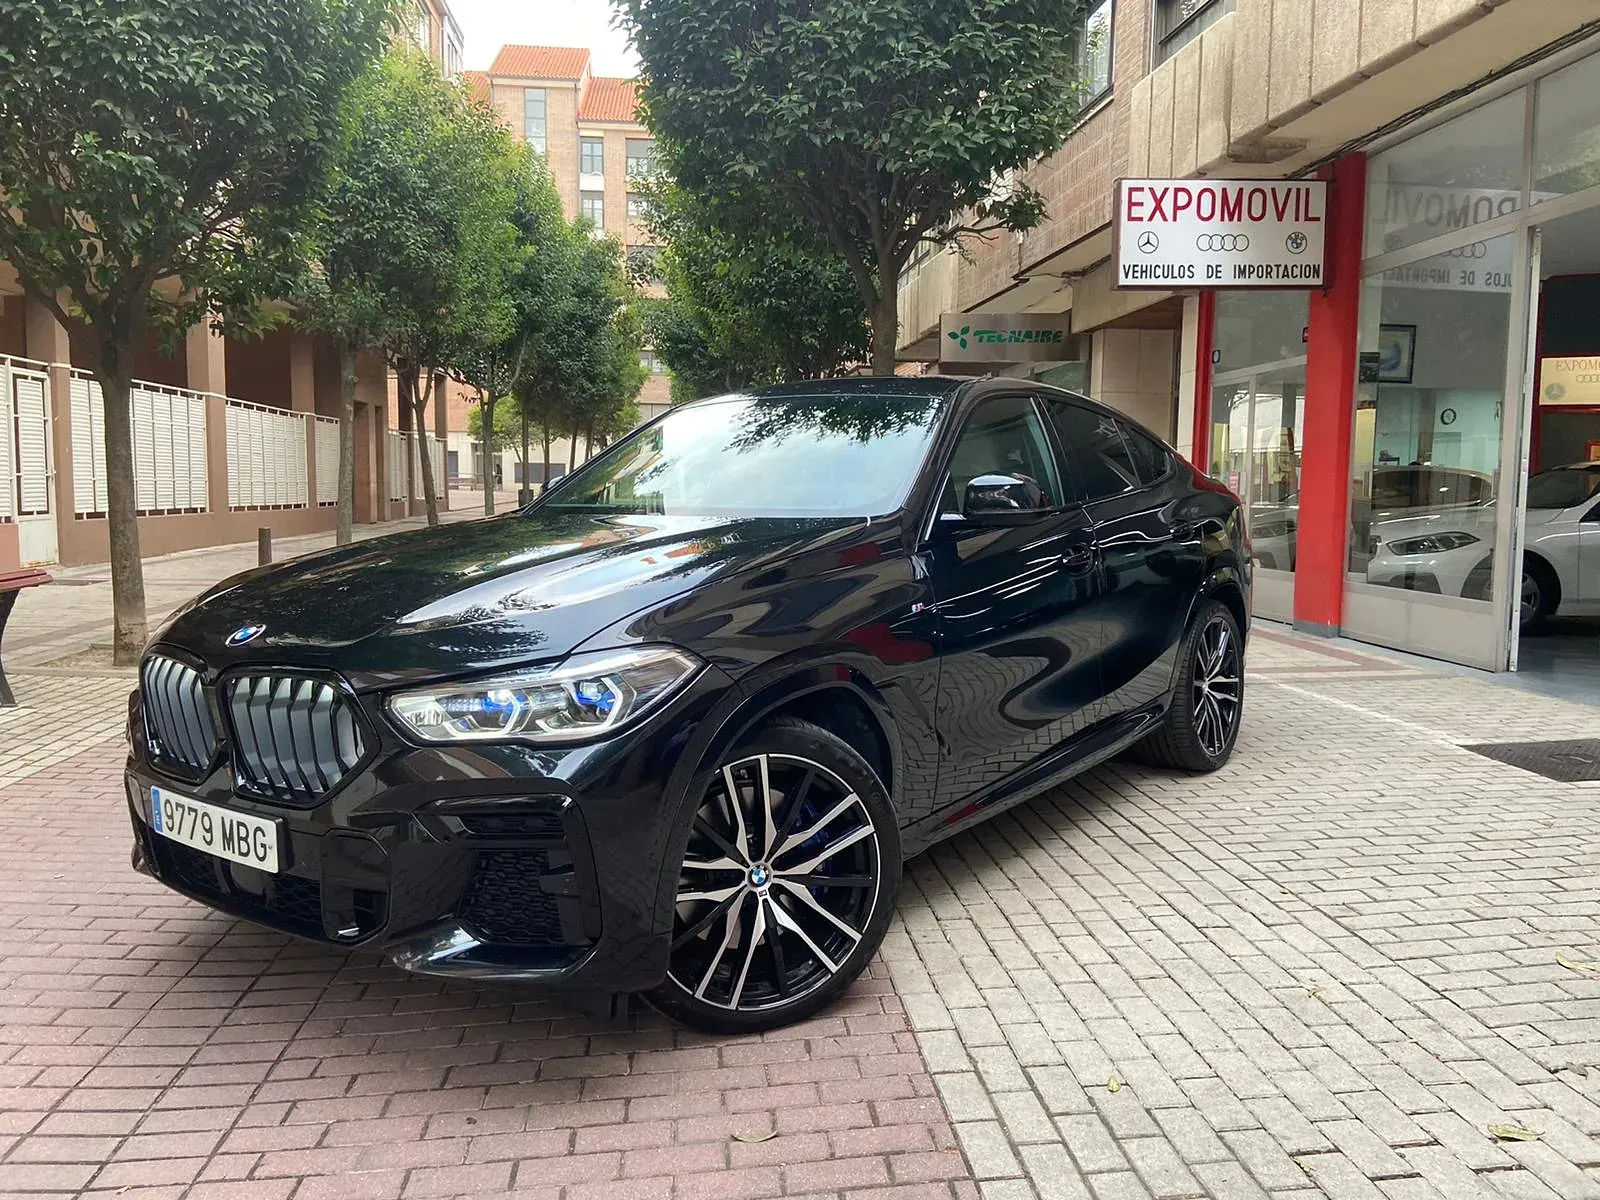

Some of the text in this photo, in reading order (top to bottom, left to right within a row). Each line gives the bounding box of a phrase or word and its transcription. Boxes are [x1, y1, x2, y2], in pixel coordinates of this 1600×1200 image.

[1126, 186, 1321, 222] EXPOMOVIL
[1122, 263, 1321, 279] VEHICULOS DE IMPORTACION
[973, 329, 1064, 344] TECNAIRE
[163, 798, 268, 862] 9779 MBG
